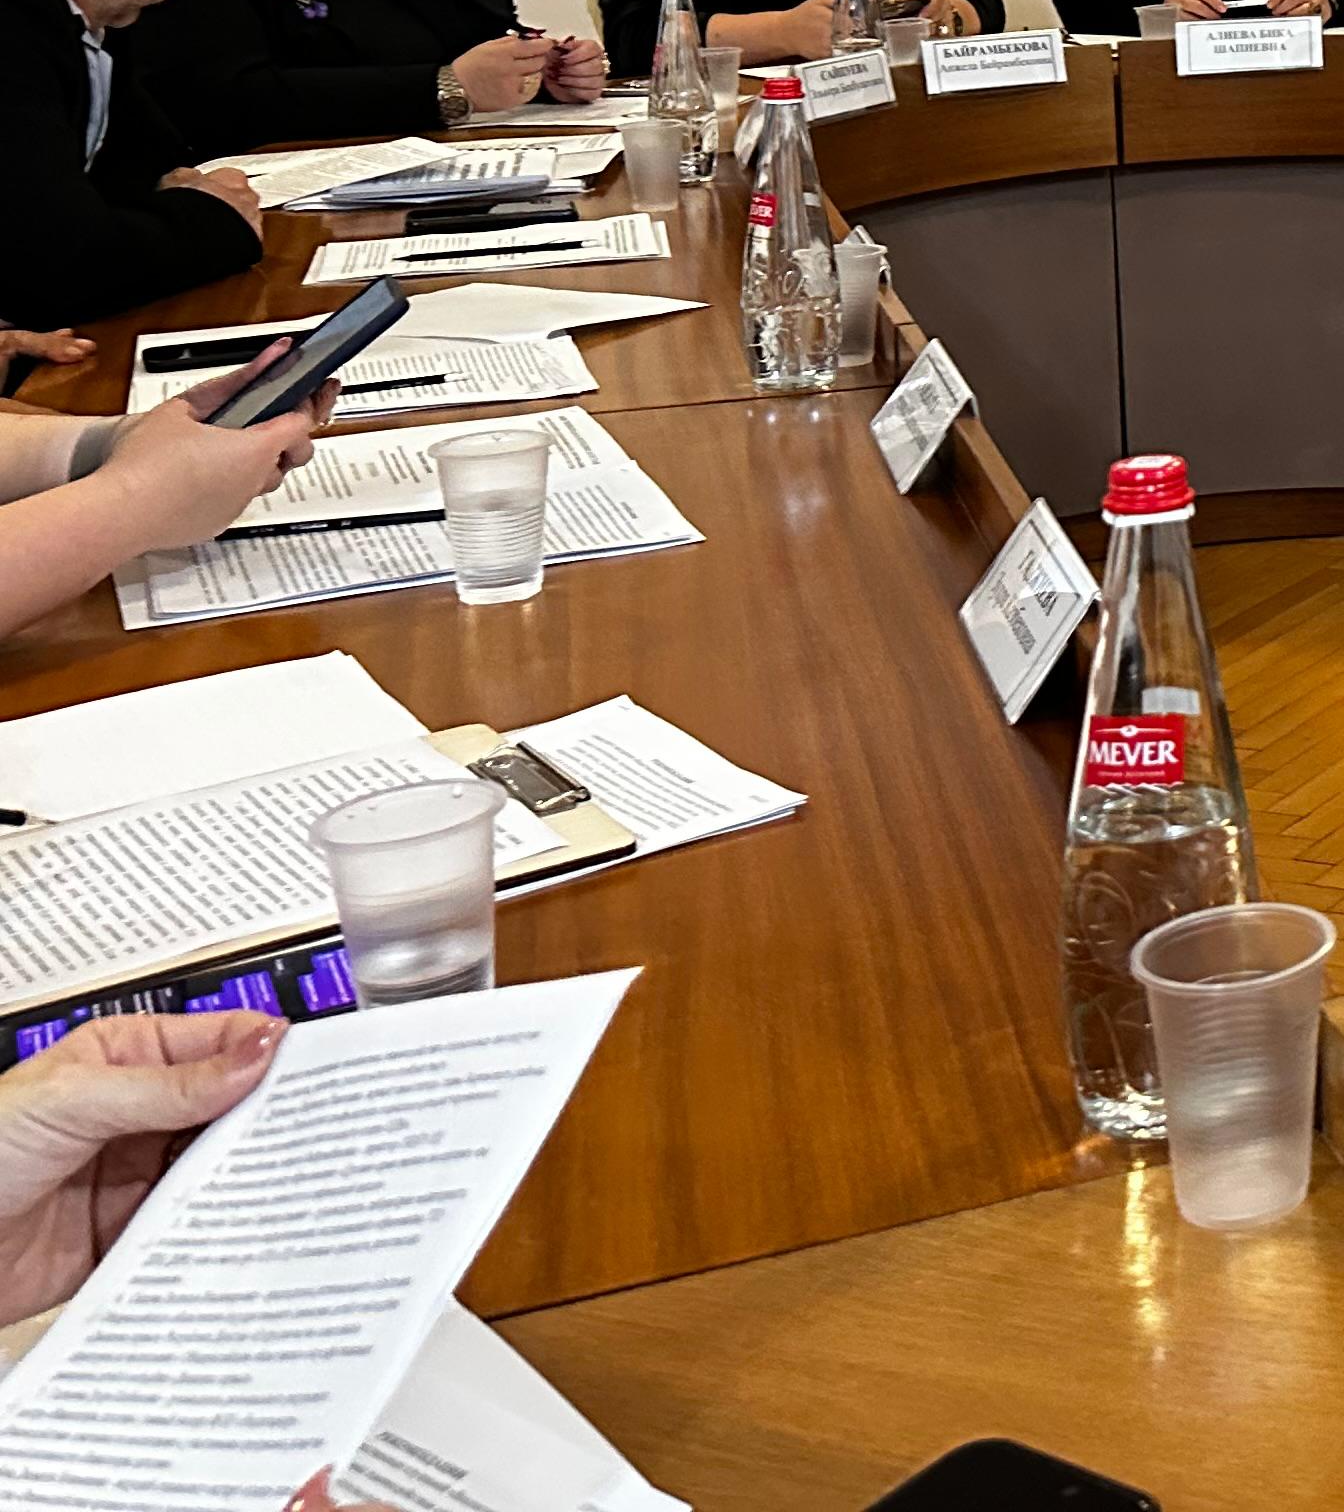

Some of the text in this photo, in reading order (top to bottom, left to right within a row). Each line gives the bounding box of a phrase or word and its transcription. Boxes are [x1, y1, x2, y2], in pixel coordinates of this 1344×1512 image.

[1206, 29, 1257, 42] АЛИЕВА
[943, 40, 1049, 59] БАЙРАМБЕКОВА
[1088, 740, 1179, 766] MEVER
